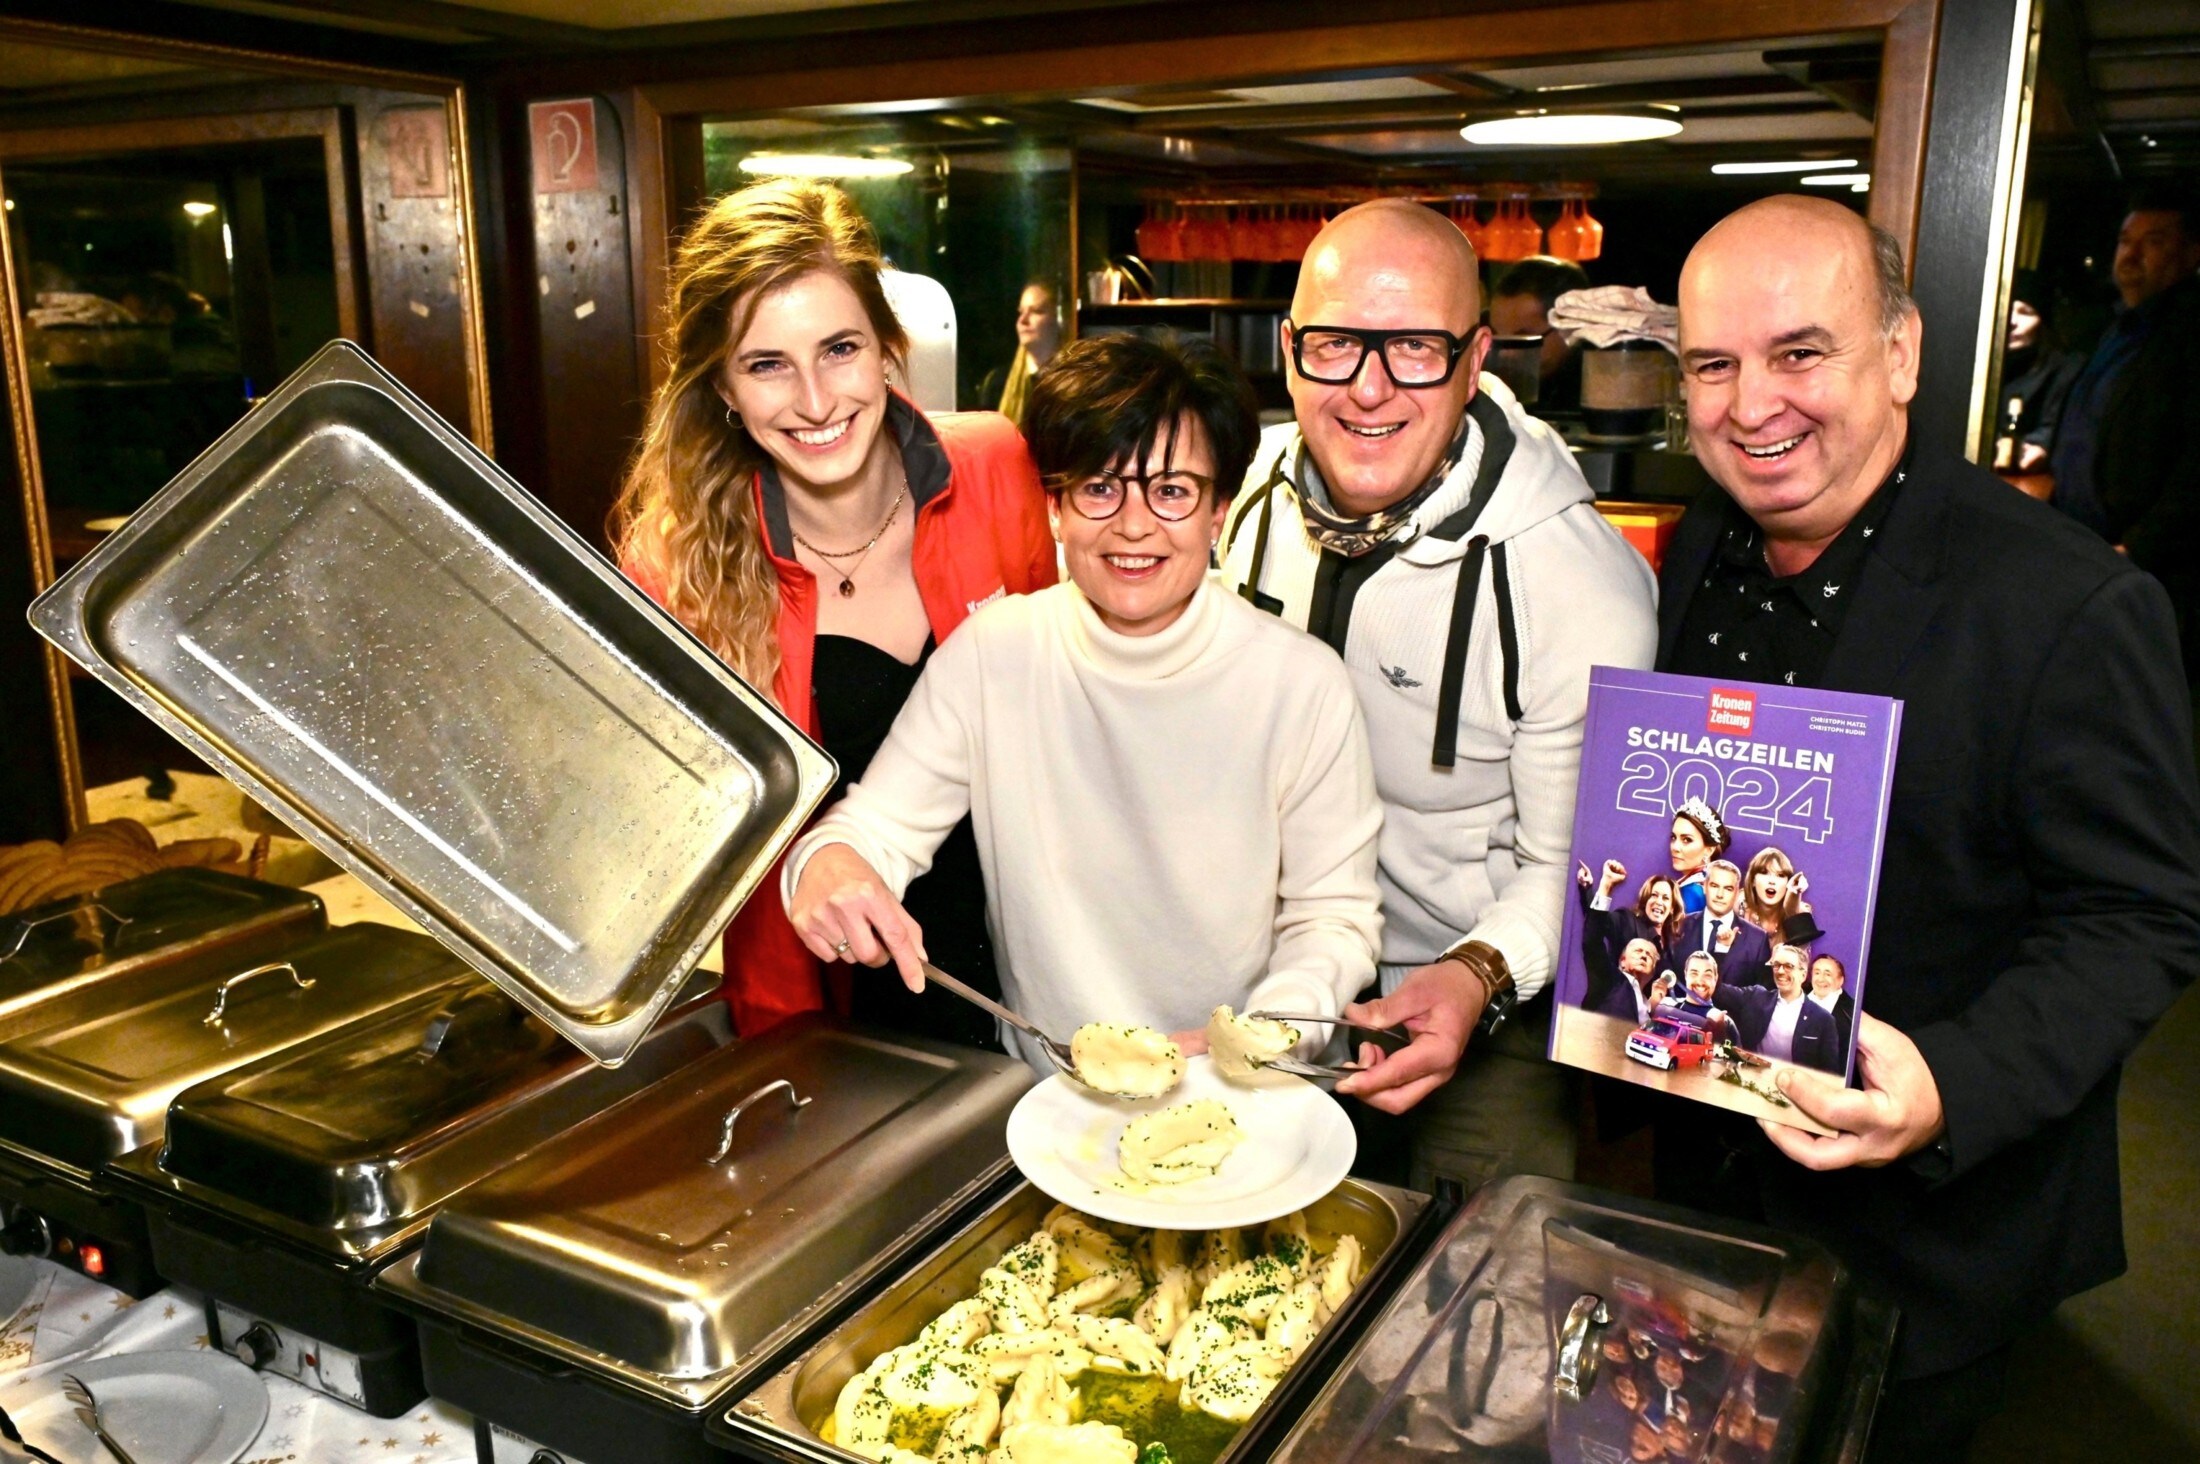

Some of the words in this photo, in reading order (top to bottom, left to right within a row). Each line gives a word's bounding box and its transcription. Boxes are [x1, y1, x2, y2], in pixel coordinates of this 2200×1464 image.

[1711, 693, 1753, 712] Kronen
[1710, 709, 1751, 730] Zeitung
[1810, 716, 1846, 726] CHRISTOPH
[1846, 720, 1867, 729] MATZL
[1809, 724, 1845, 734] CHRISTOPH
[1845, 728, 1866, 737] BUDIN
[1626, 726, 1834, 774] SCHLAGZEILEN
[1616, 751, 1834, 844] 2024
